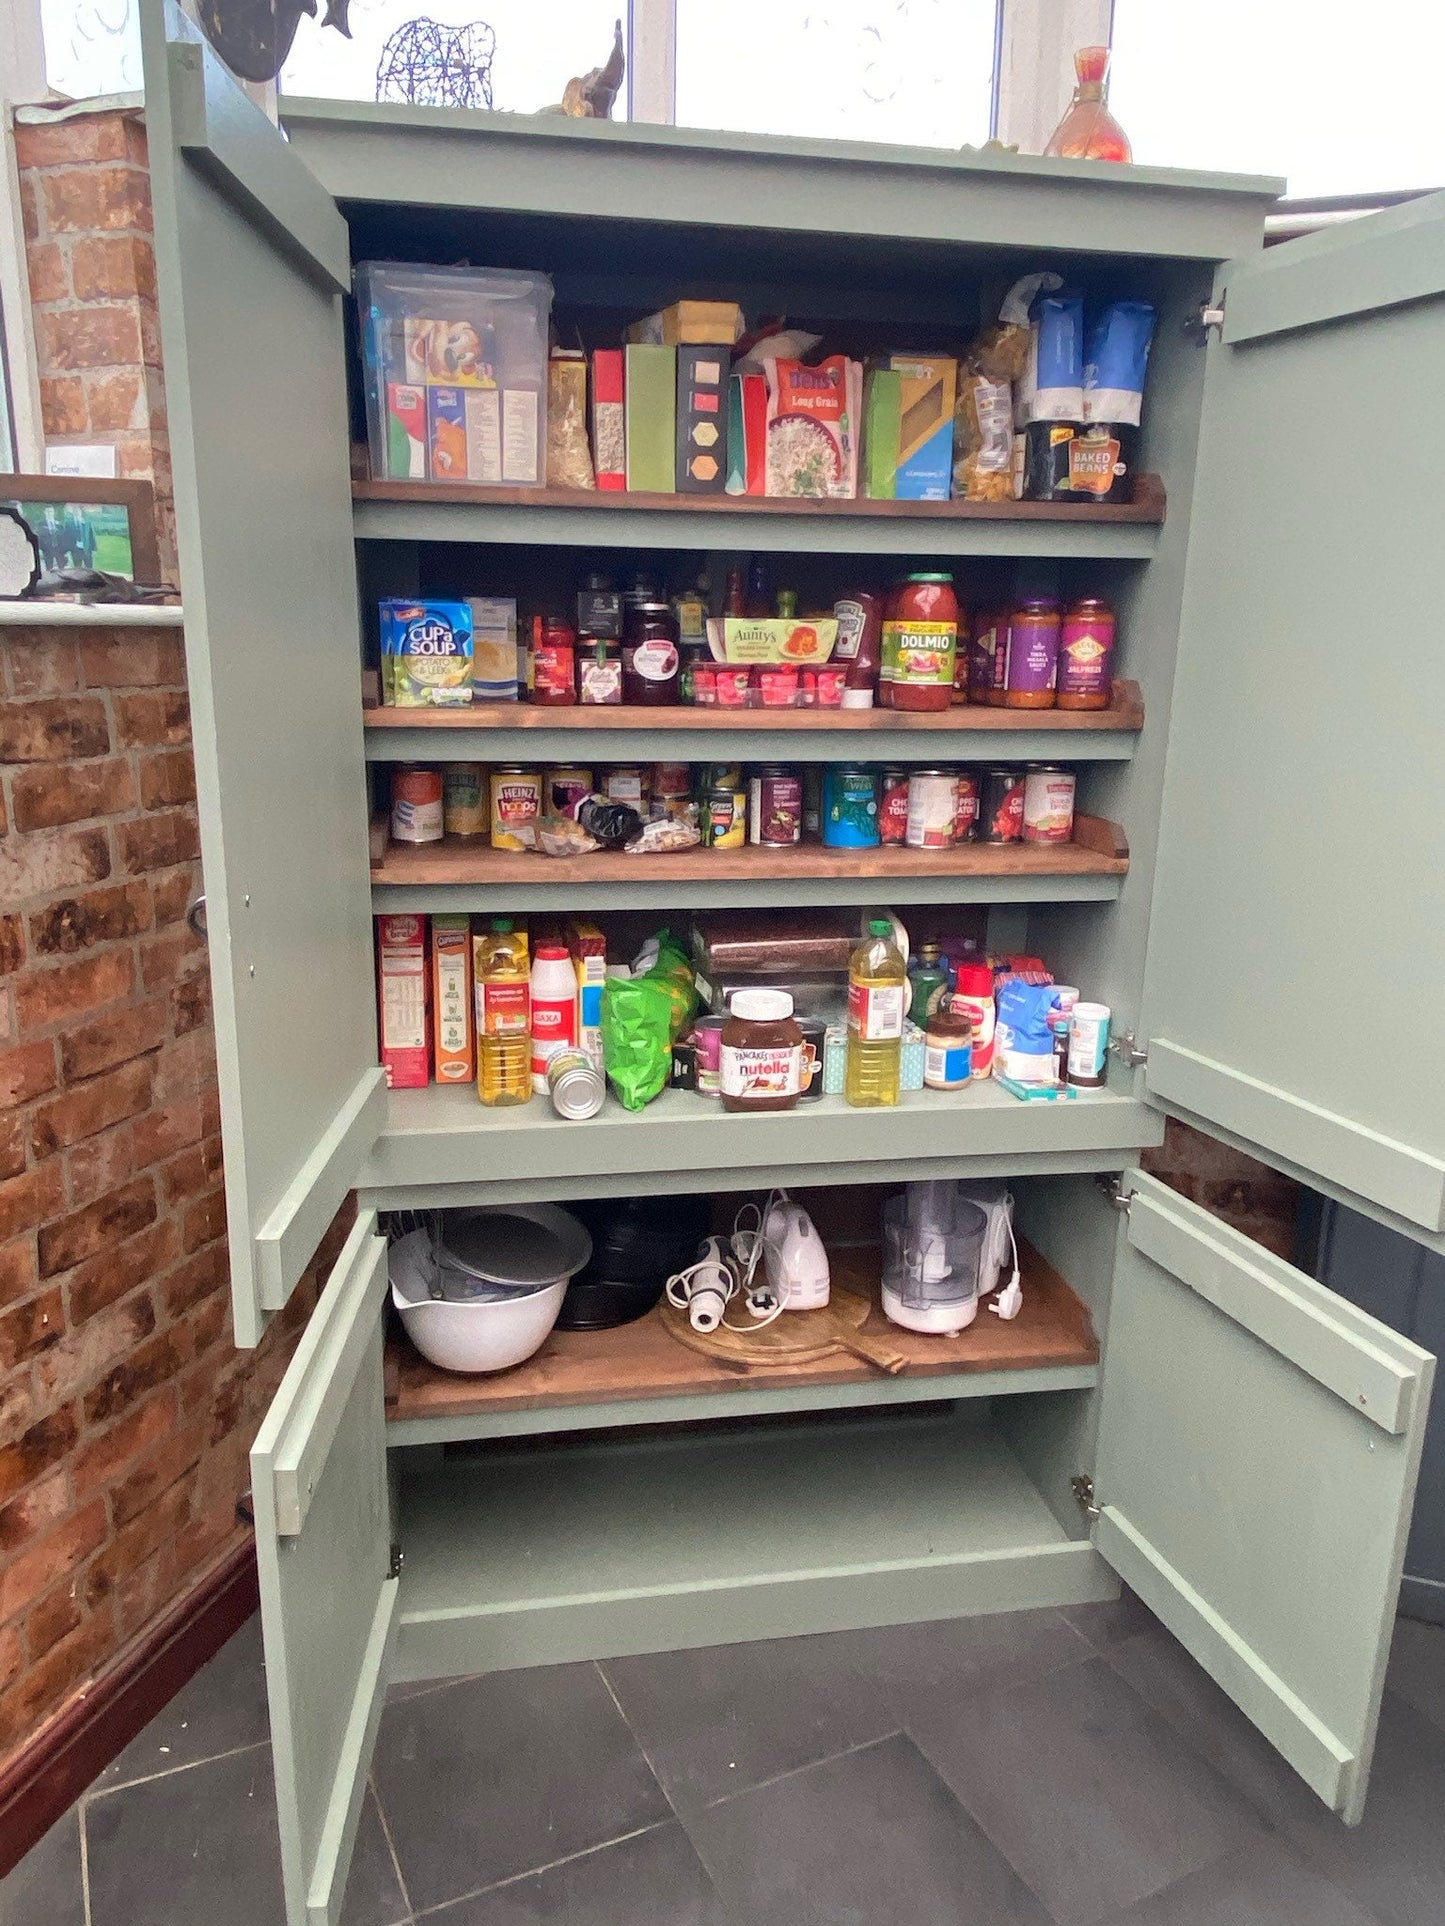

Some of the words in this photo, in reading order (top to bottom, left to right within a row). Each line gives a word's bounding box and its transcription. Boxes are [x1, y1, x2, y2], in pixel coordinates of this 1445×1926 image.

[791, 395, 814, 409] Long
[815, 396, 839, 408] Grain
[1074, 452, 1111, 463] BAKED
[1073, 463, 1109, 475] BEANS
[733, 629, 777, 644] Aunty's
[900, 634, 950, 650] DOLMIO
[409, 641, 456, 655] SOUP
[1067, 665, 1102, 674] JALFREZI
[503, 787, 534, 798] HEINZ
[500, 801, 537, 813] hoops
[535, 1014, 559, 1022] SAXA
[739, 1061, 790, 1075] nutella
